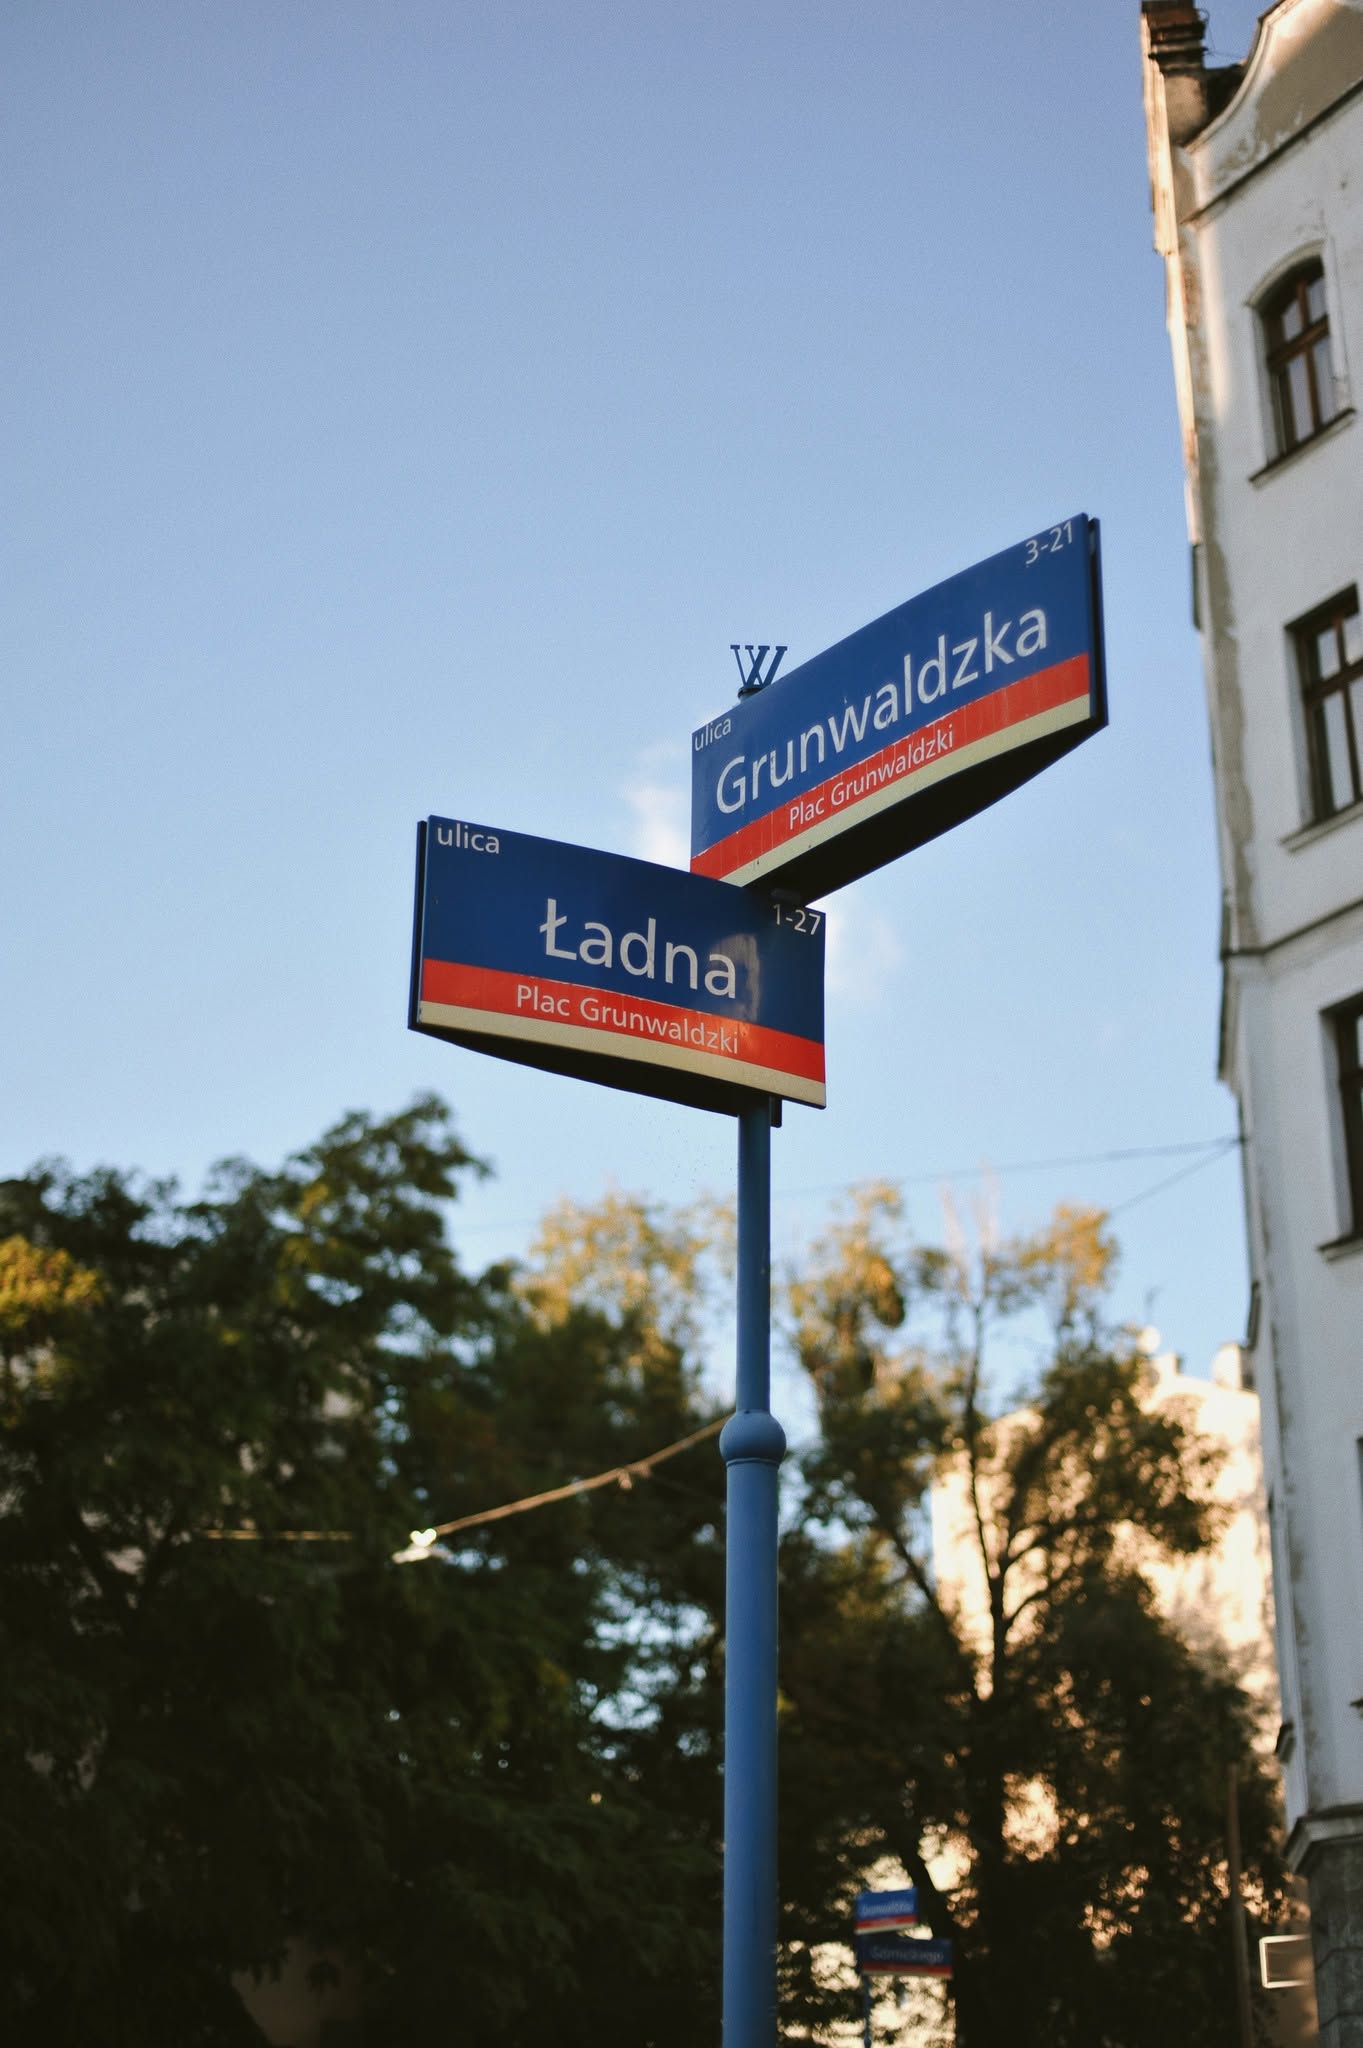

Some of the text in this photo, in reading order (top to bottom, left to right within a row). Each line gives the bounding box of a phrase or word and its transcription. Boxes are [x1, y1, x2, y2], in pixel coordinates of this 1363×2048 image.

[1025, 521, 1073, 565] 3-21
[694, 715, 732, 752] ulica
[716, 608, 1048, 814] Grunwaldzka
[790, 729, 953, 829] Plac Grunwaldzki
[436, 824, 500, 854] ulica
[539, 897, 737, 998] Ładna
[773, 904, 821, 935] 1-27
[516, 985, 738, 1054] Plac Grunwaldzki
